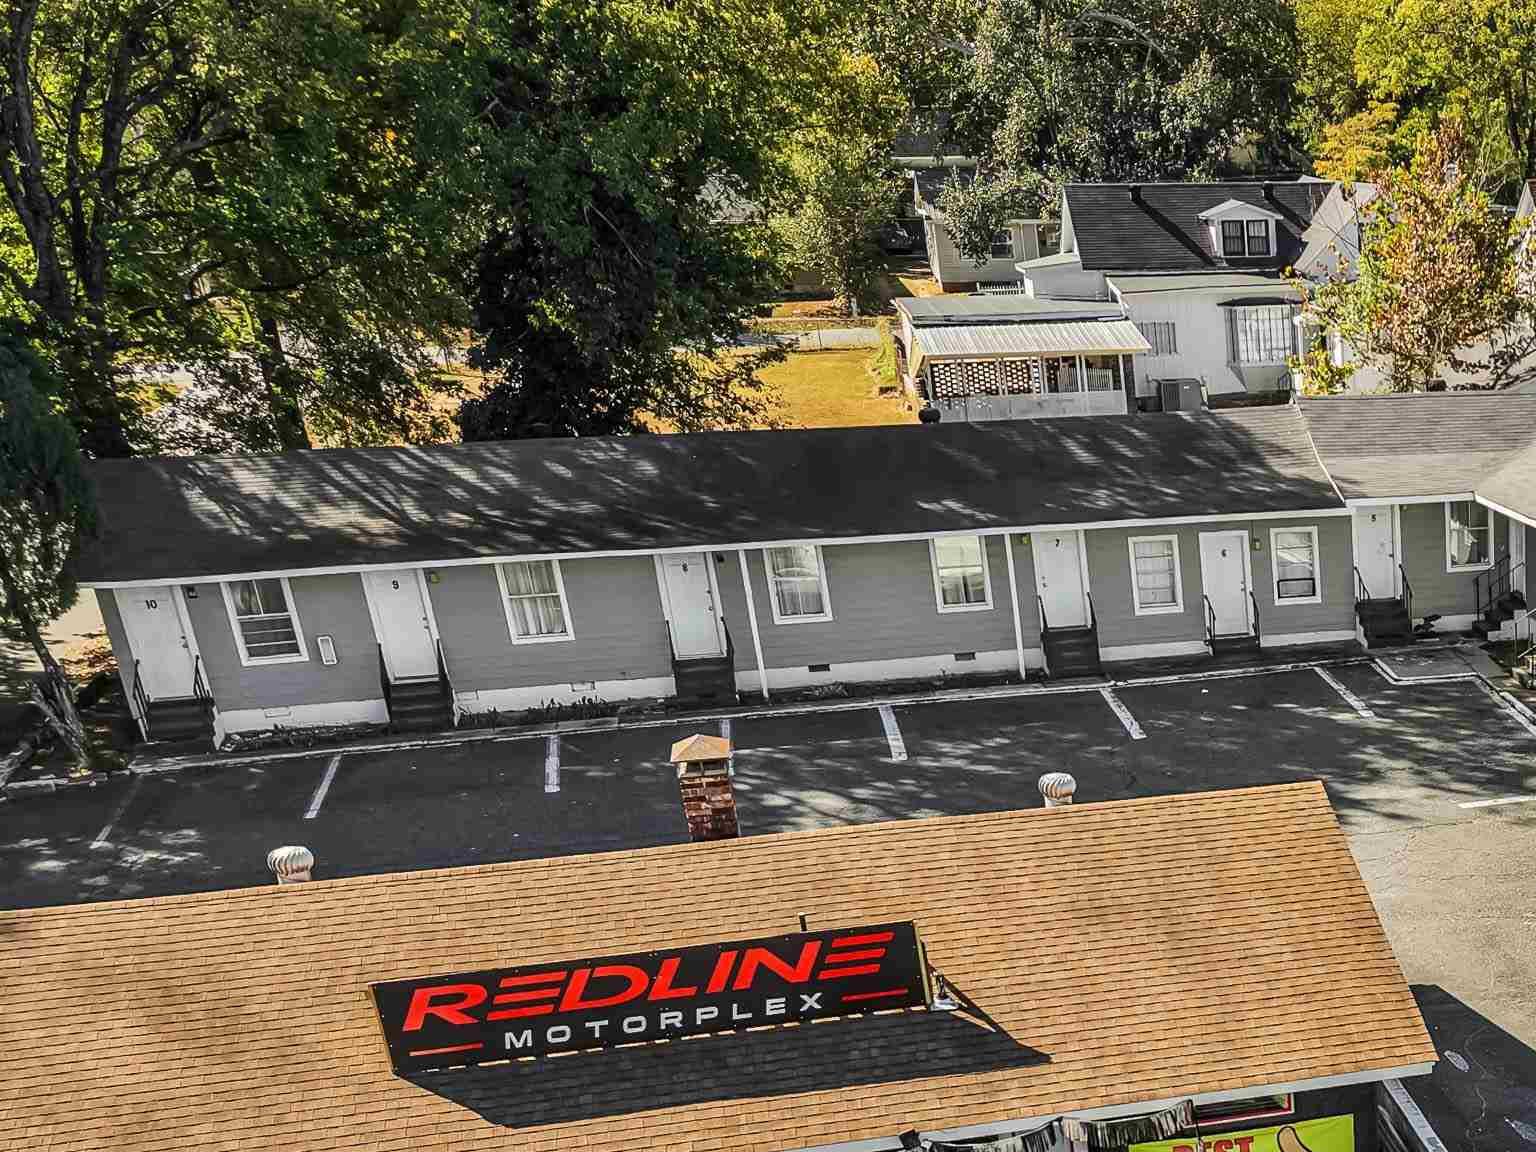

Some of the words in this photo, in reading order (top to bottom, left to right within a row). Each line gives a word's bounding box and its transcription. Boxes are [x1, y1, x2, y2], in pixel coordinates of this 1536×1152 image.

[392, 579, 400, 590] 9
[145, 599, 158, 610] 10
[402, 931, 894, 1031] REDLINE
[505, 992, 823, 1049] MOTORPLEX
